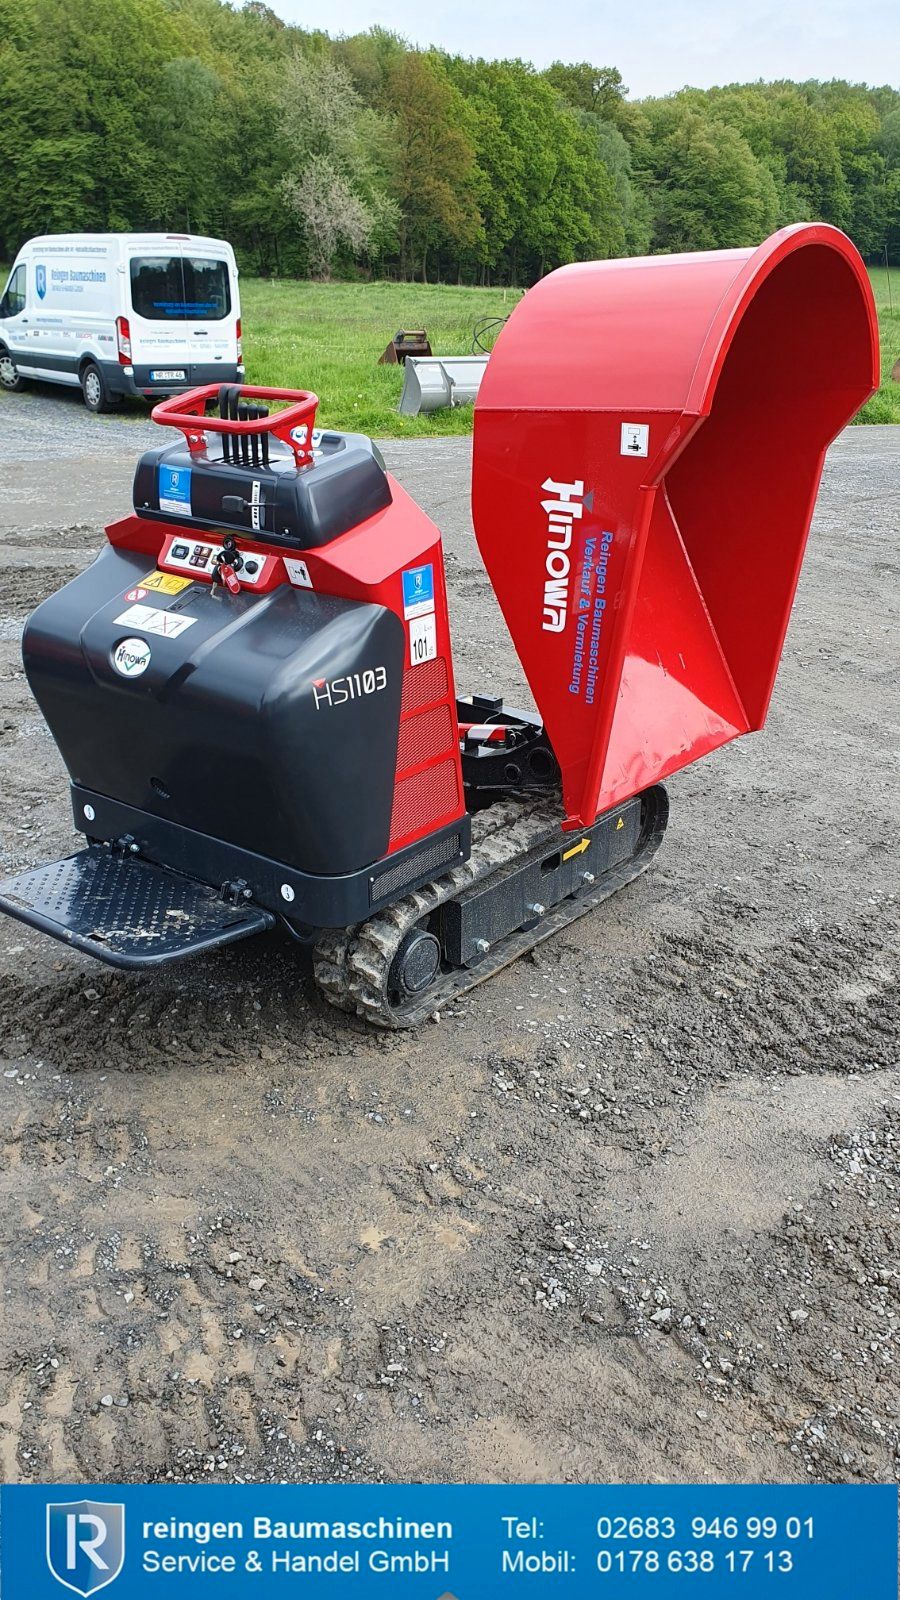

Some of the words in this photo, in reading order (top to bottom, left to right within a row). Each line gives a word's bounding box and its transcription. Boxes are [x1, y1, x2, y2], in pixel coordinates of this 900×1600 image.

[69, 270, 106, 282] Baumaschinen
[580, 537, 597, 597] Verkauf
[595, 531, 613, 595] Reingen
[579, 598, 591, 609] &
[413, 635, 428, 660] 101
[569, 614, 589, 695] Vermietung
[585, 598, 606, 704] Baumaschinen
[312, 666, 387, 710] HS1103
